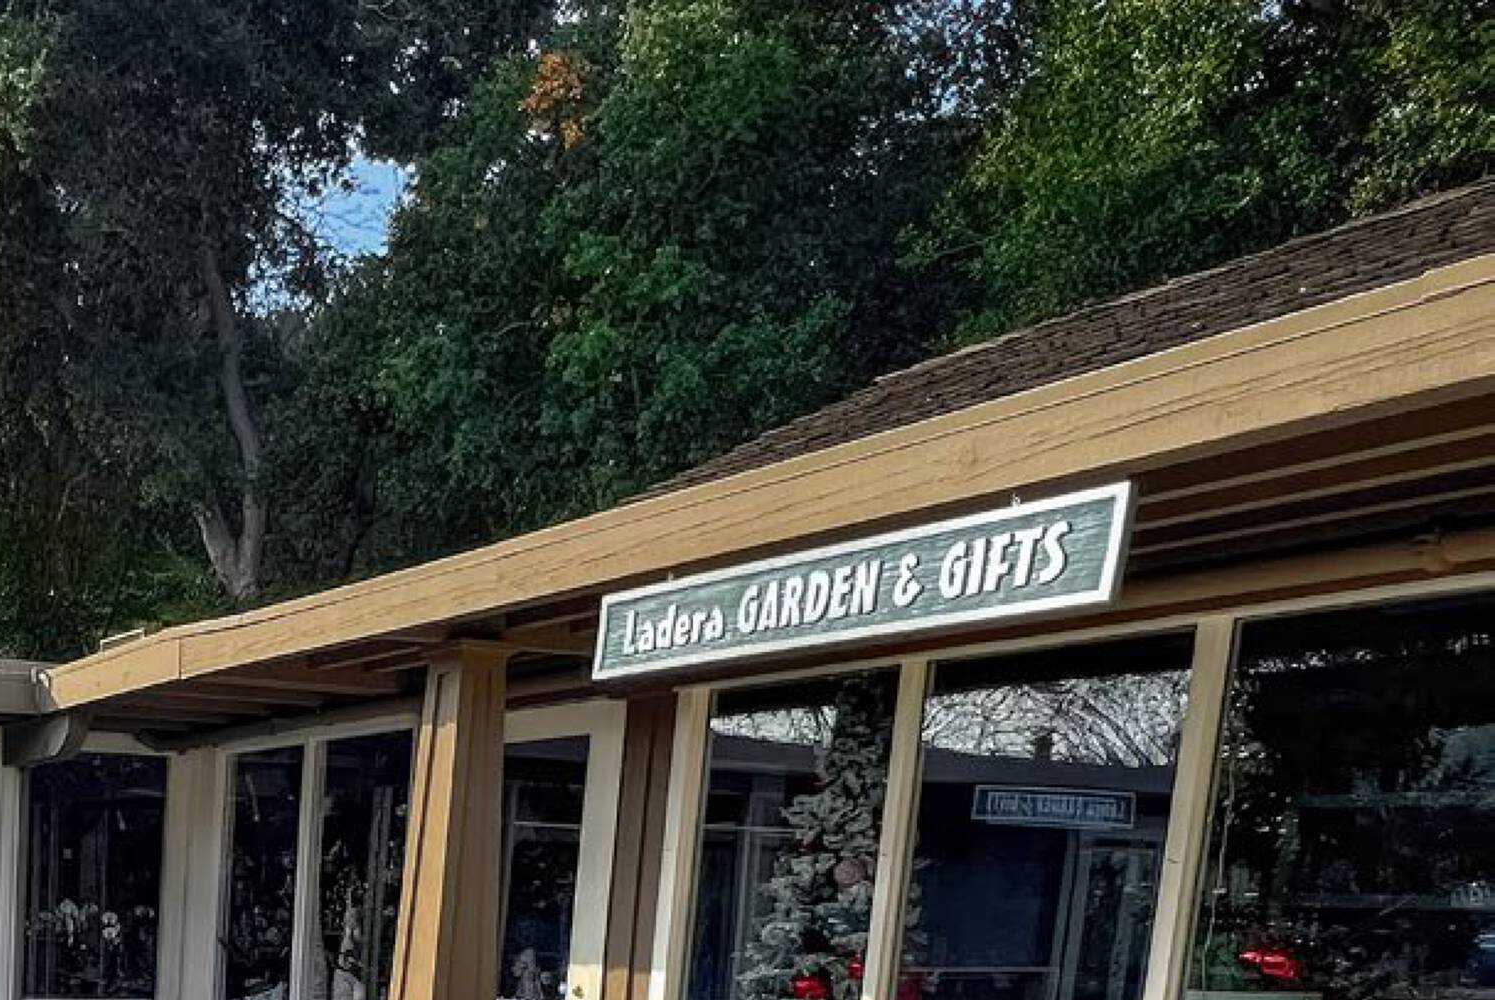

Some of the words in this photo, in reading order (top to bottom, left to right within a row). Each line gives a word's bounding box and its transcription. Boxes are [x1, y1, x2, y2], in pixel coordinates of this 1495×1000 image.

[623, 603, 725, 655] Ladera
[737, 558, 882, 634] GARDEN
[894, 552, 925, 608] &
[938, 521, 1072, 600] GIFTS
